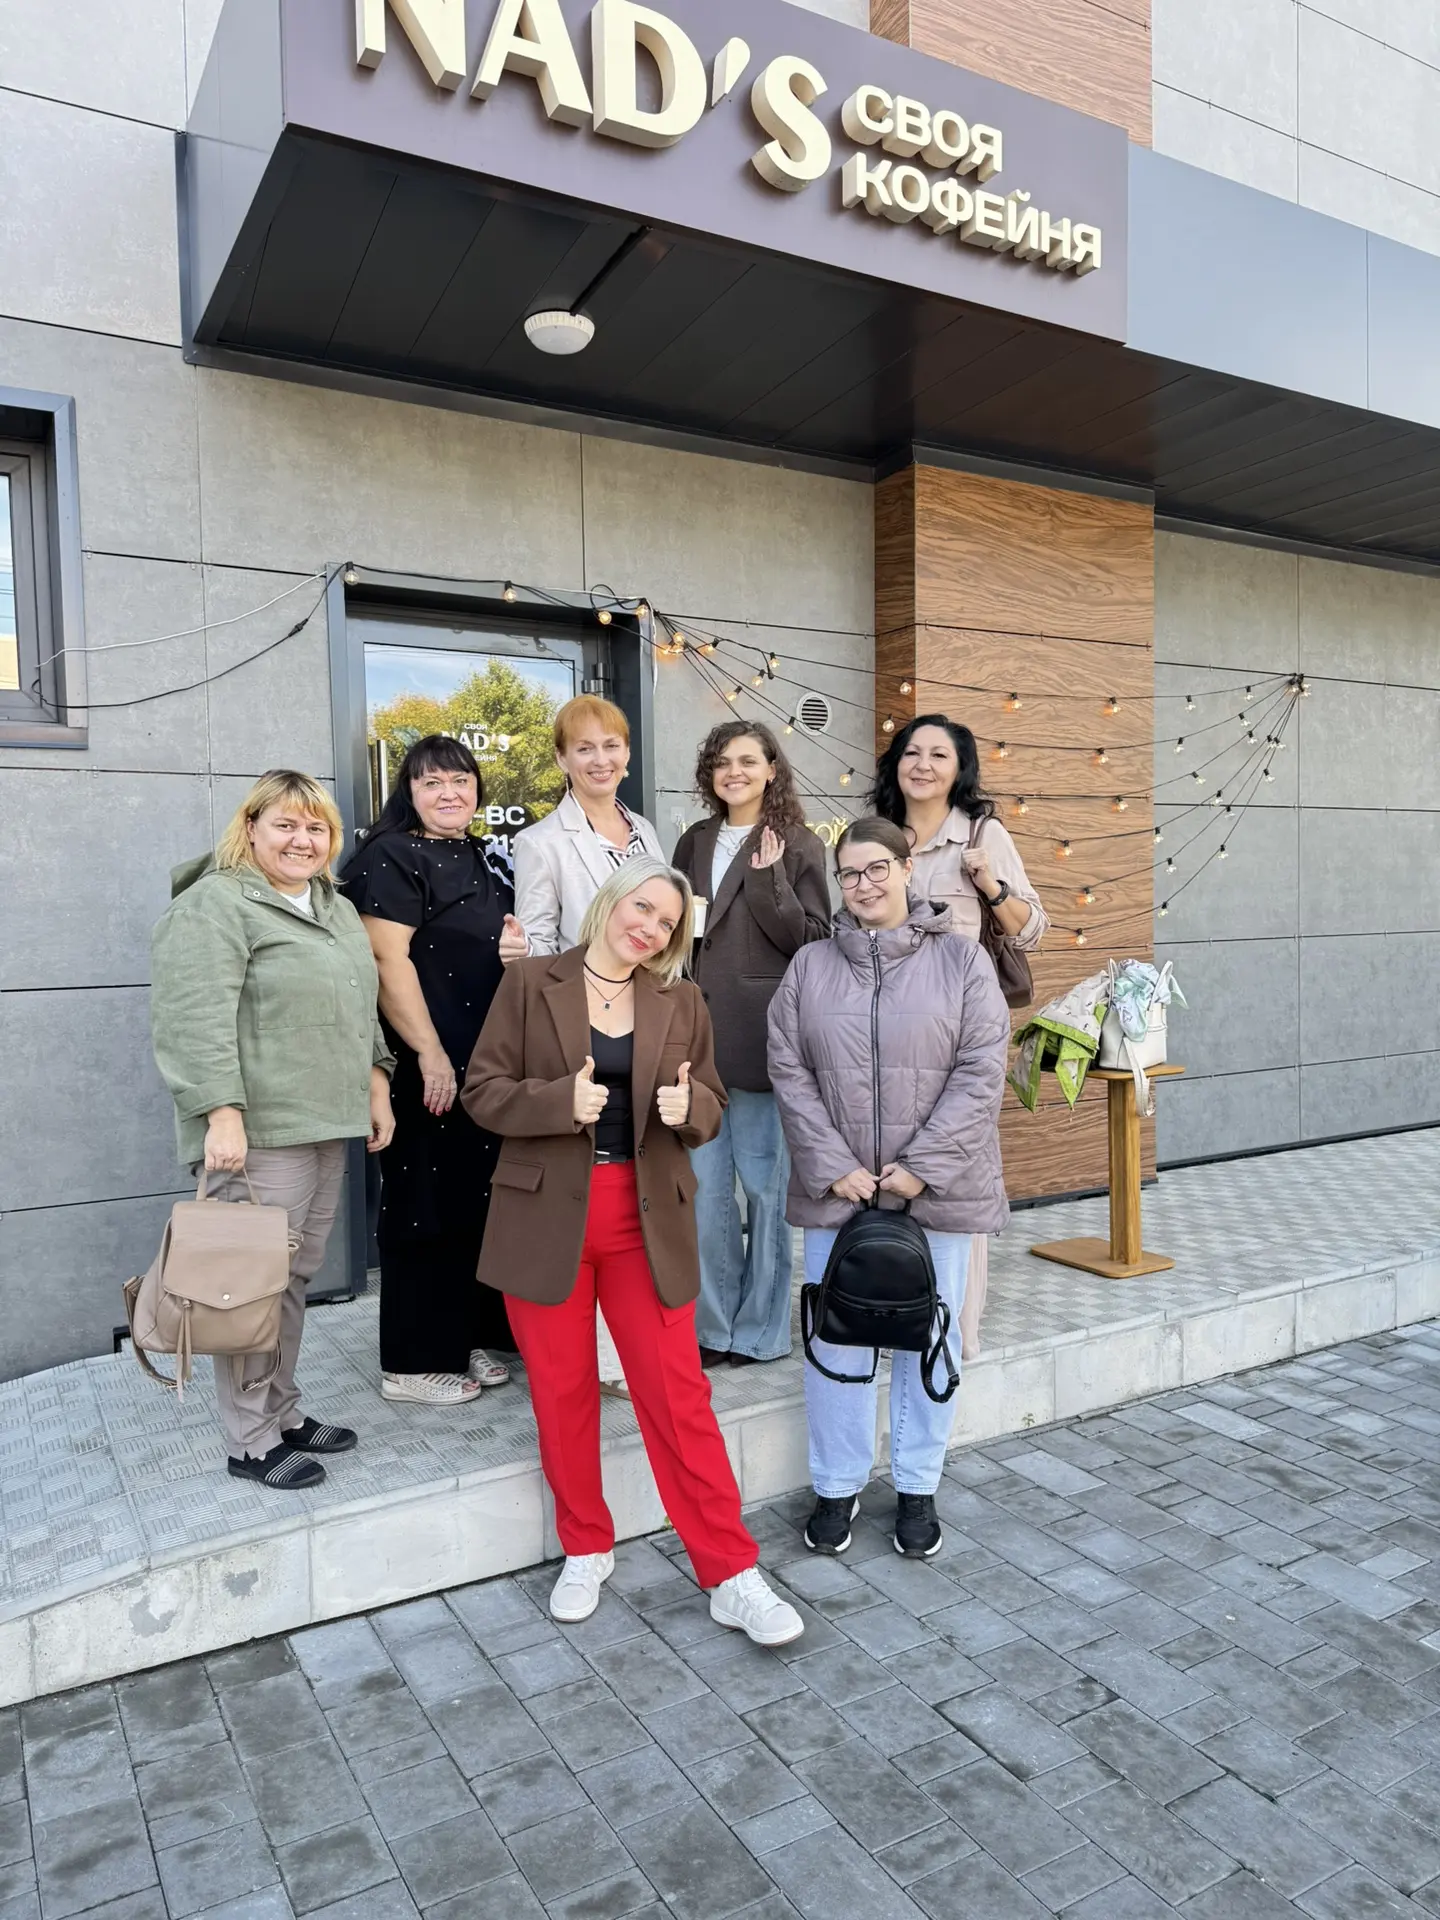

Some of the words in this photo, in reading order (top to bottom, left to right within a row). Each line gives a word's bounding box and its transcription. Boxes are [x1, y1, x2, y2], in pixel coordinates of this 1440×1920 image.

[842, 85, 1003, 182] СВОЯ
[842, 152, 1102, 276] КОФЕЙНЯ
[464, 722, 488, 731] СВОЯ
